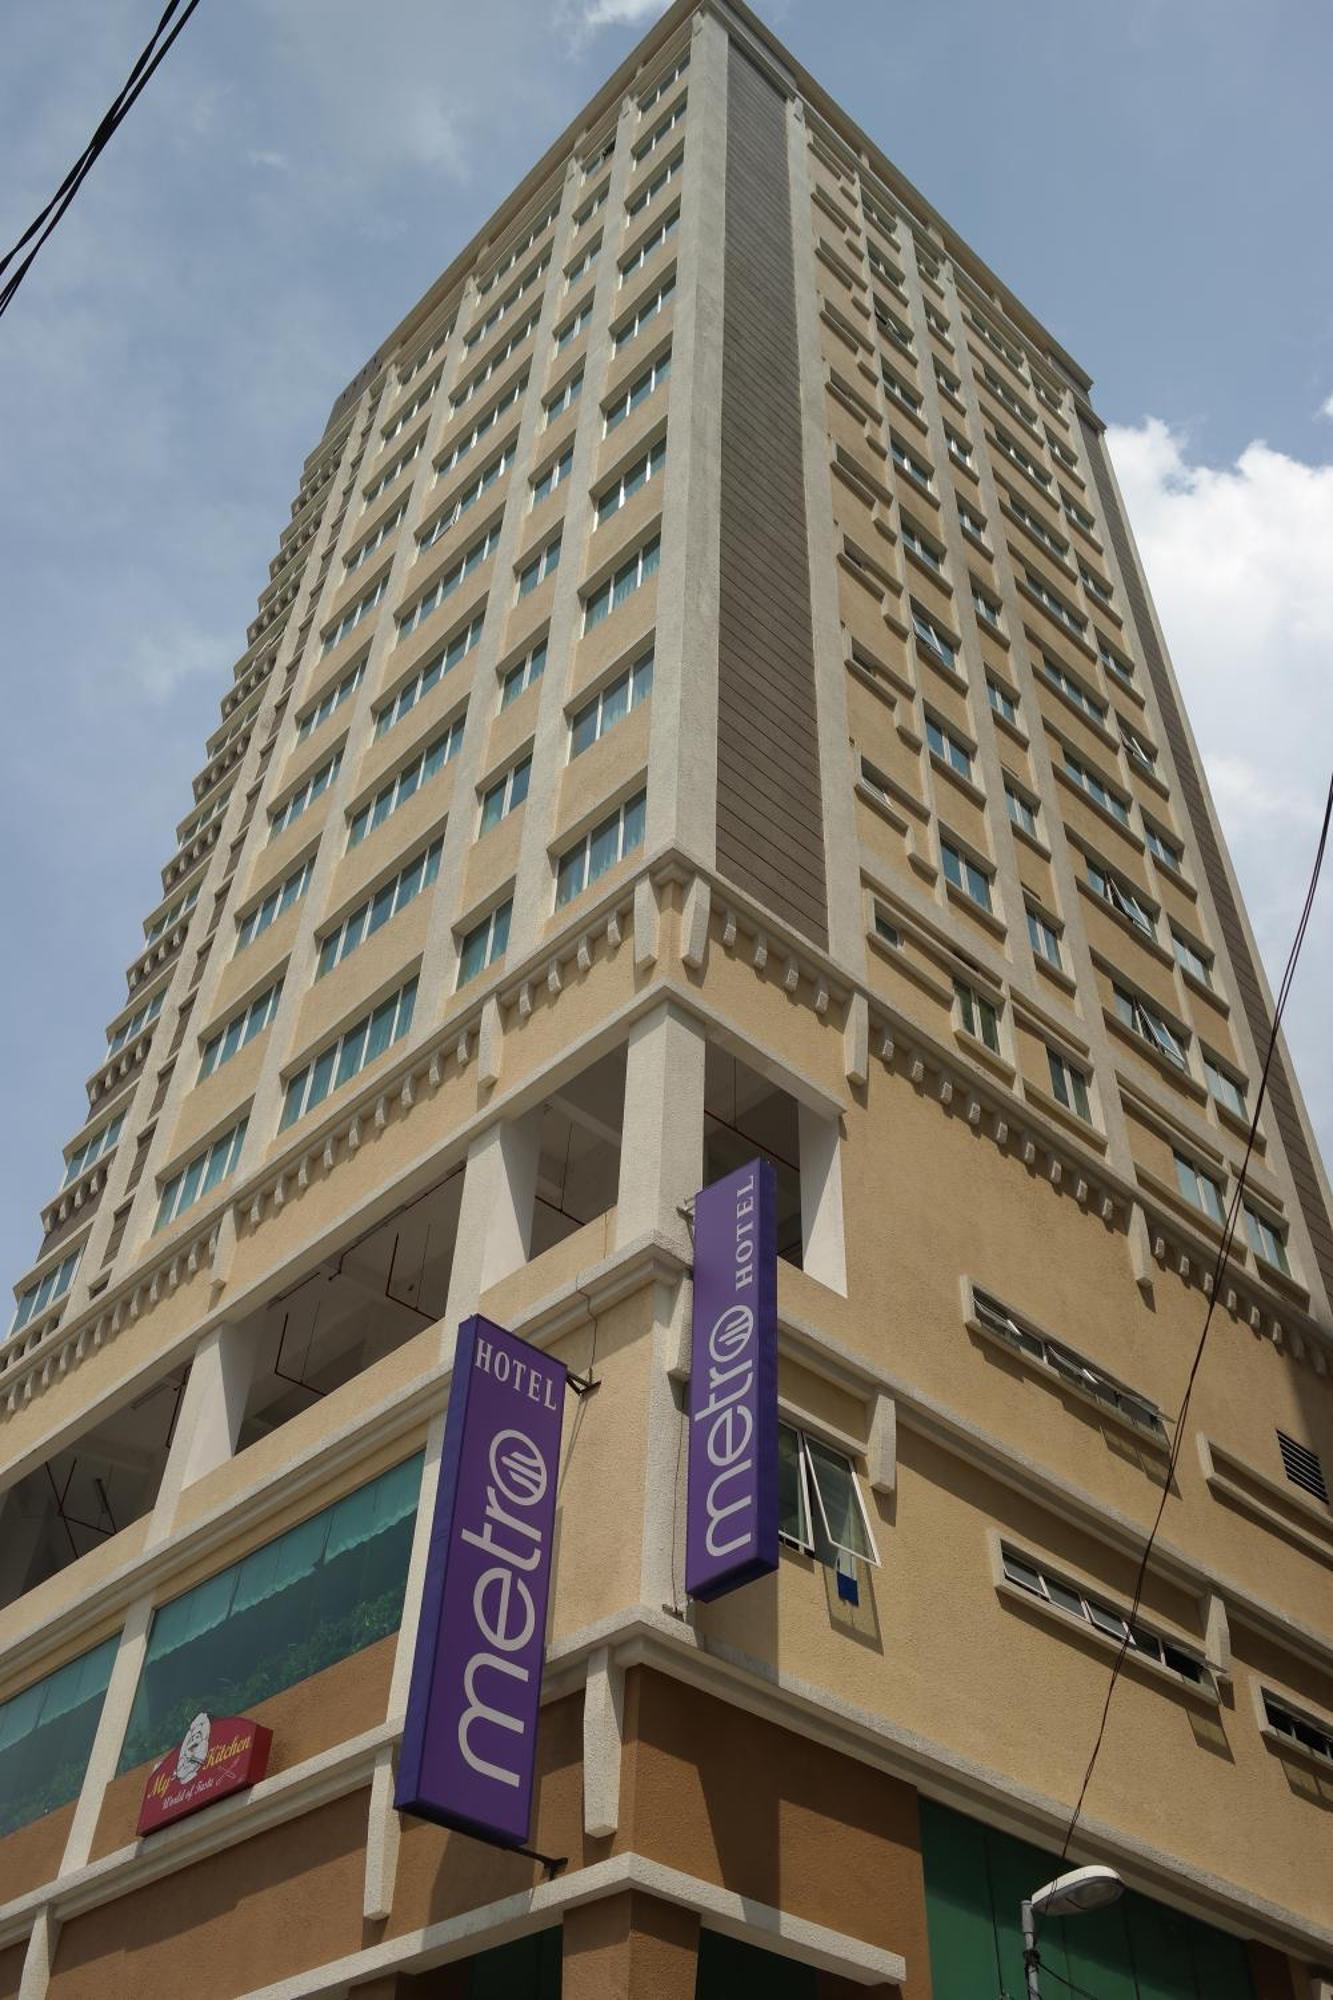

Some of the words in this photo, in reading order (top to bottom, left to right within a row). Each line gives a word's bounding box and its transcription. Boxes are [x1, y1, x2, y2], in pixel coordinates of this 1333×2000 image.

[735, 1174, 754, 1292] HOTEL
[474, 1337, 558, 1411] HOTEL
[694, 1303, 755, 1558] metro
[457, 1427, 548, 1789] metro
[148, 1773, 173, 1798] My
[202, 1735, 251, 1770] Kitchen
[162, 1789, 186, 1810] World
